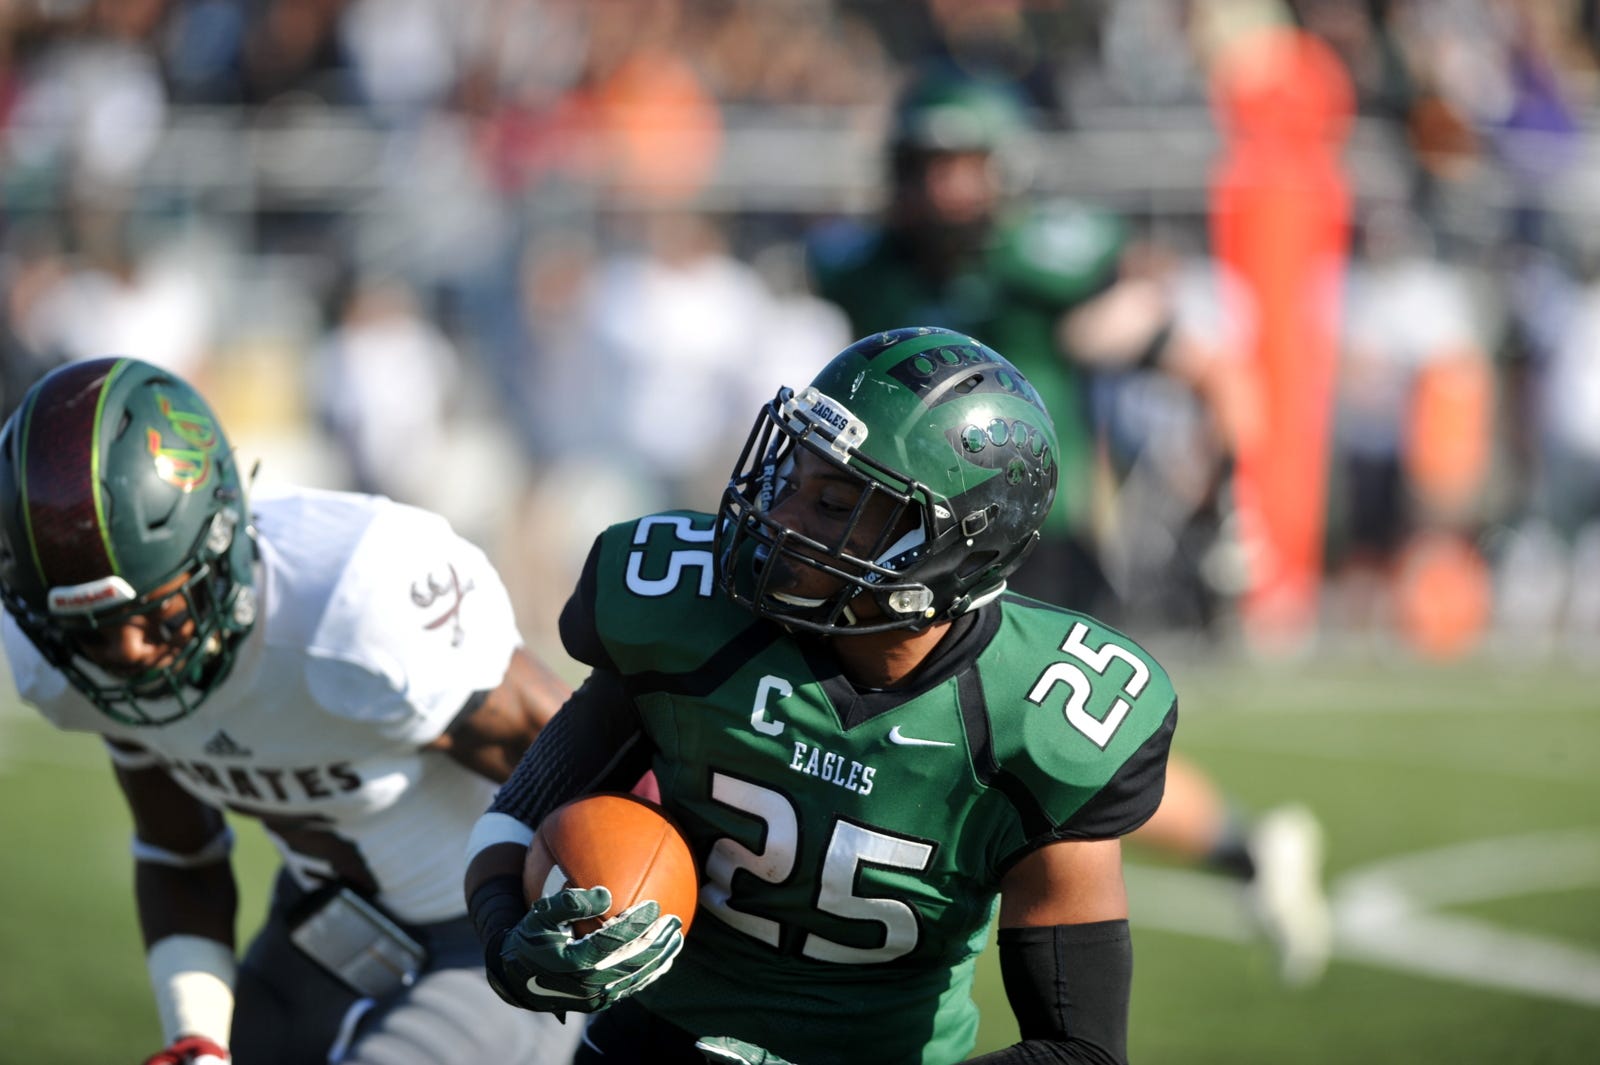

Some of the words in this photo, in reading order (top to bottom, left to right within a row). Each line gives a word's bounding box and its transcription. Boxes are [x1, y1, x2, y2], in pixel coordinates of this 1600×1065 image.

[811, 401, 848, 431] EAGLES
[626, 515, 730, 597] 25
[751, 675, 793, 736] C
[1027, 621, 1150, 749] 25
[174, 760, 362, 801] RATES
[789, 741, 877, 796] EAGLES
[700, 771, 933, 965] 25
